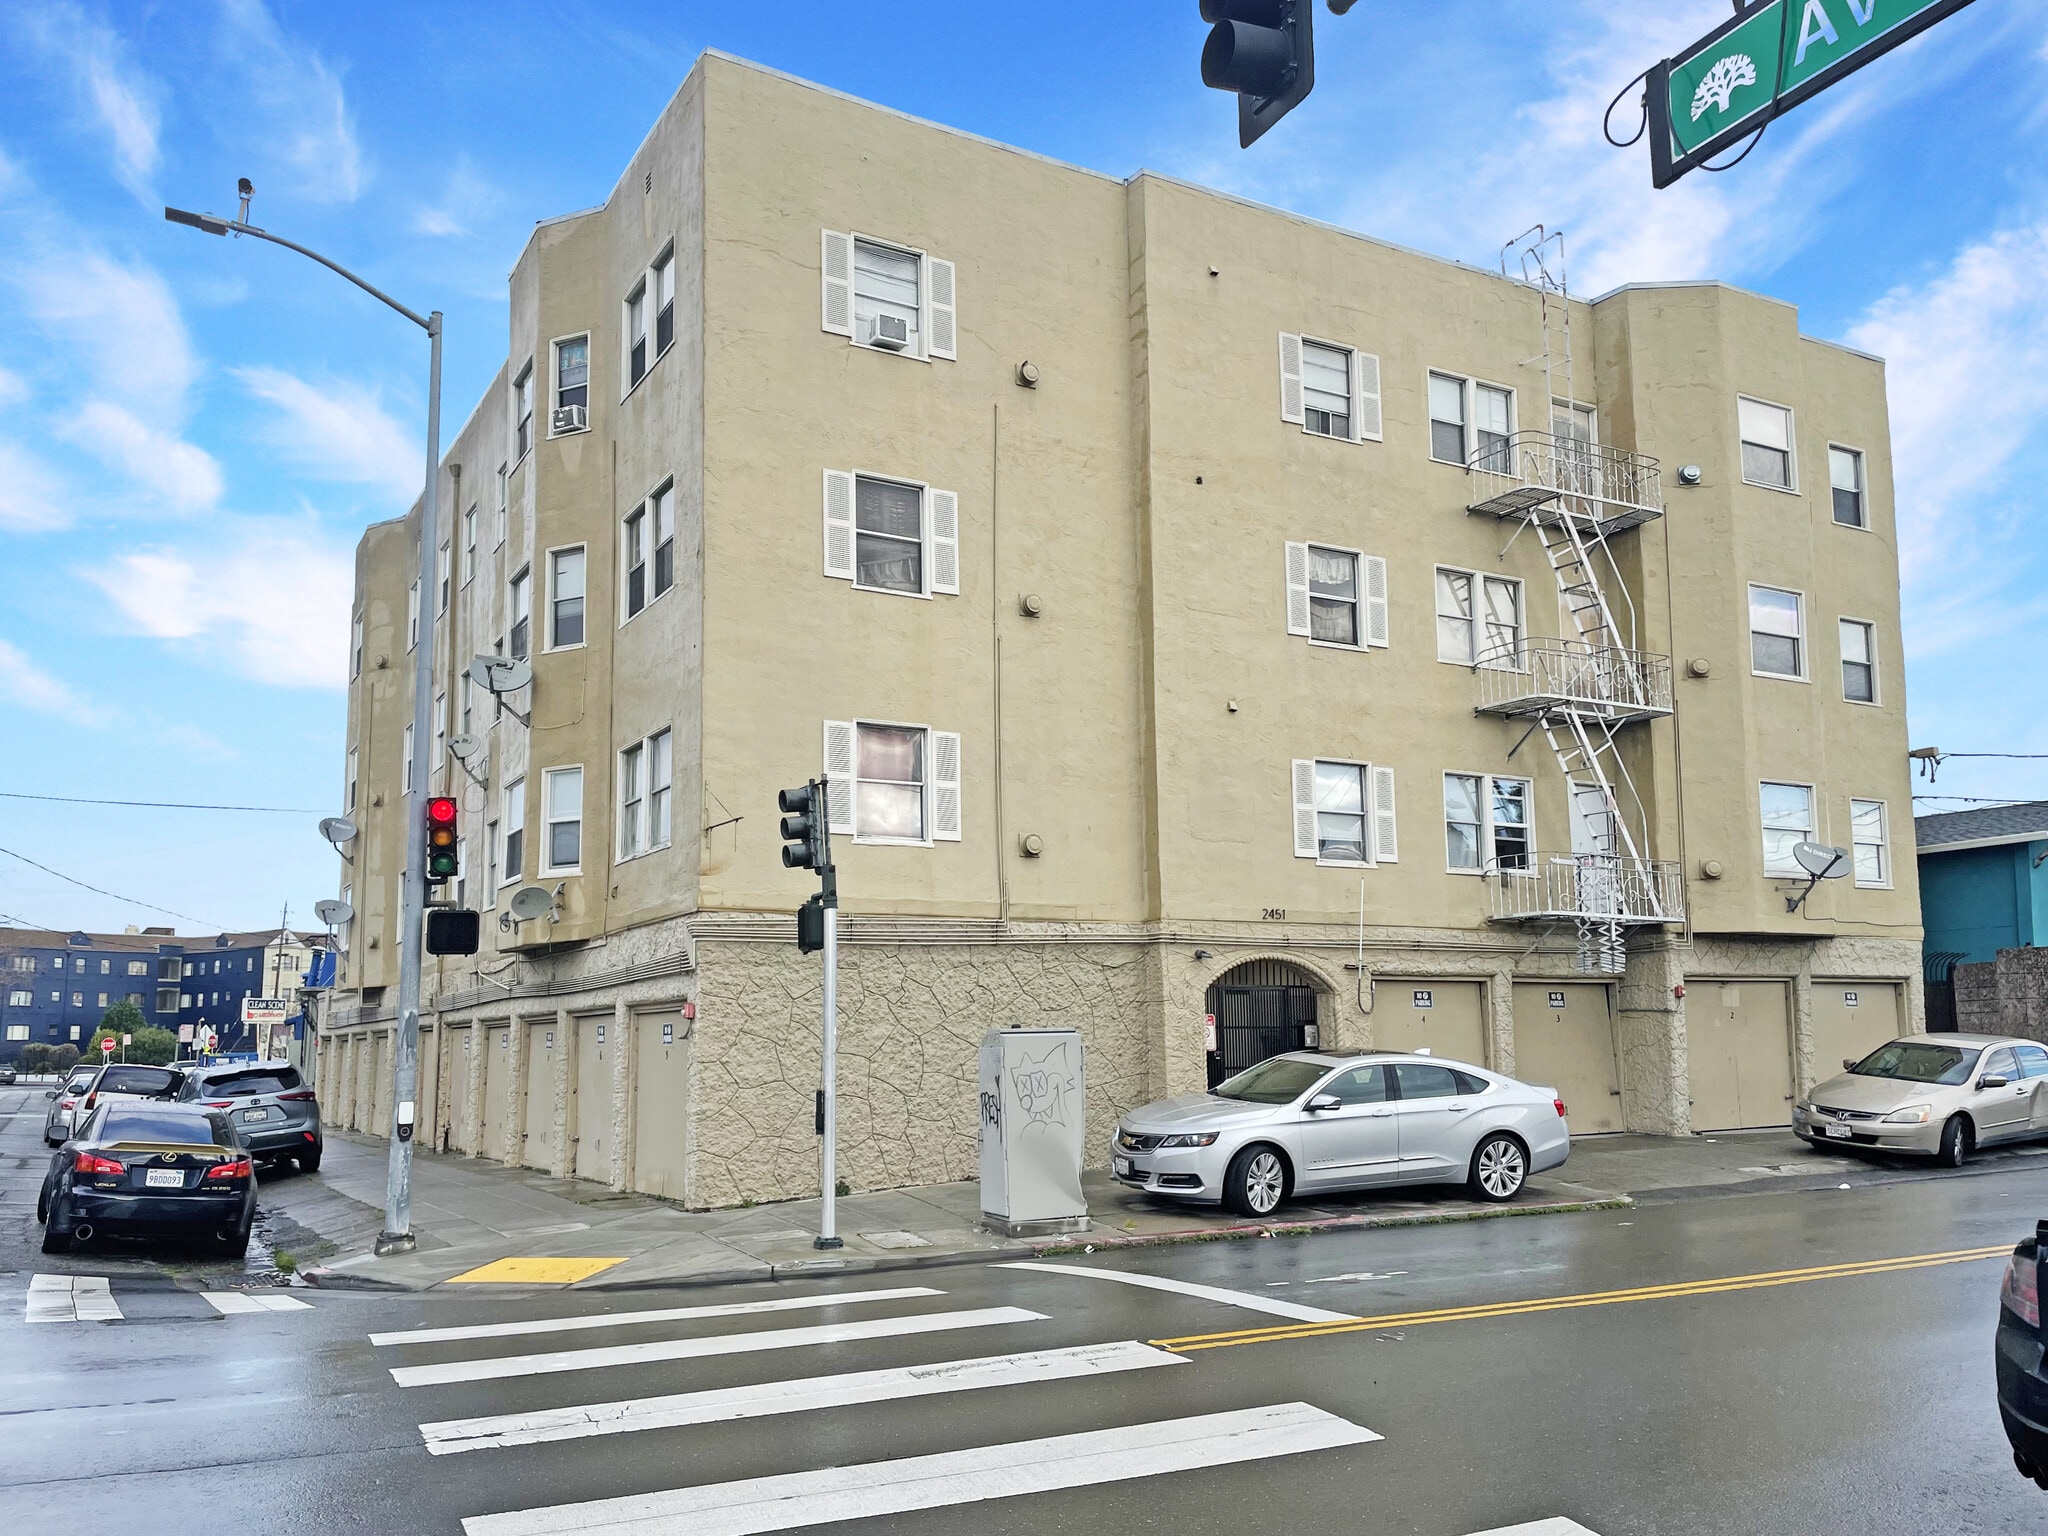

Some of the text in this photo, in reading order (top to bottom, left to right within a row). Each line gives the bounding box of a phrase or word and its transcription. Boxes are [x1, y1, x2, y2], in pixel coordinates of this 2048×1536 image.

[1813, 849, 1836, 860] DIRECT
[1262, 909, 1285, 919] 2451
[248, 1001, 266, 1009] CLEAN
